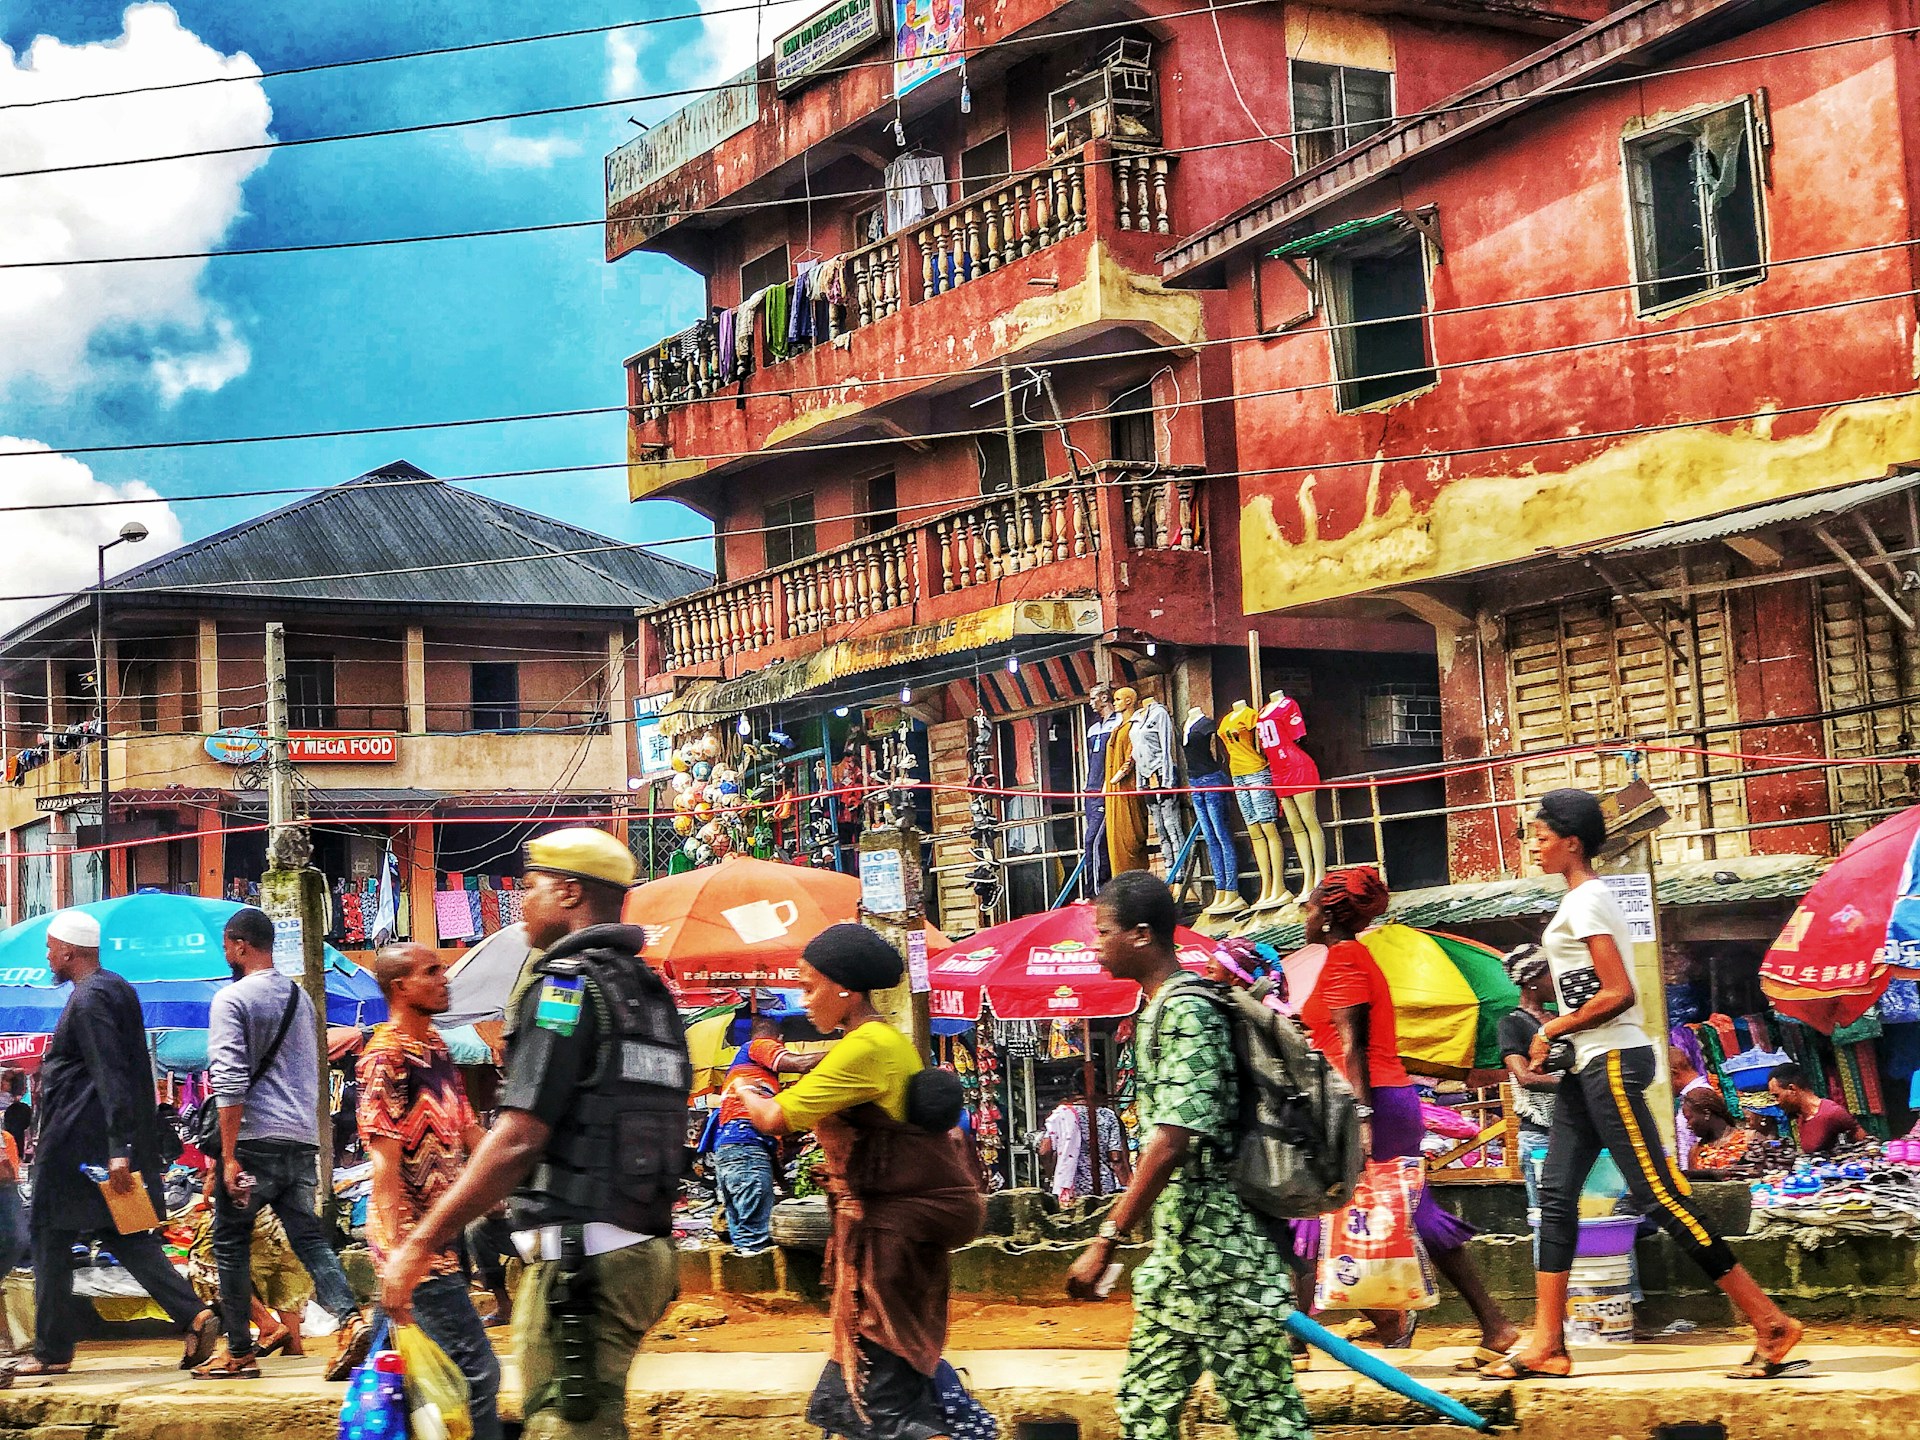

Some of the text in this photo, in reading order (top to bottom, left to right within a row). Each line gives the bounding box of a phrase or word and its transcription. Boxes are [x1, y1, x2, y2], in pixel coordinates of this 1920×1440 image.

[903, 622, 957, 645] BOUTIQUE
[304, 737, 347, 755] MEGA
[350, 737, 393, 755] FOOD
[861, 851, 898, 863] JOB
[1032, 950, 1097, 964] DANO
[935, 958, 990, 973] DANO
[1026, 965, 1056, 975] FULL
[683, 972, 693, 981] It
[695, 970, 709, 980] all
[711, 971, 743, 980] starts
[744, 971, 767, 980] with
